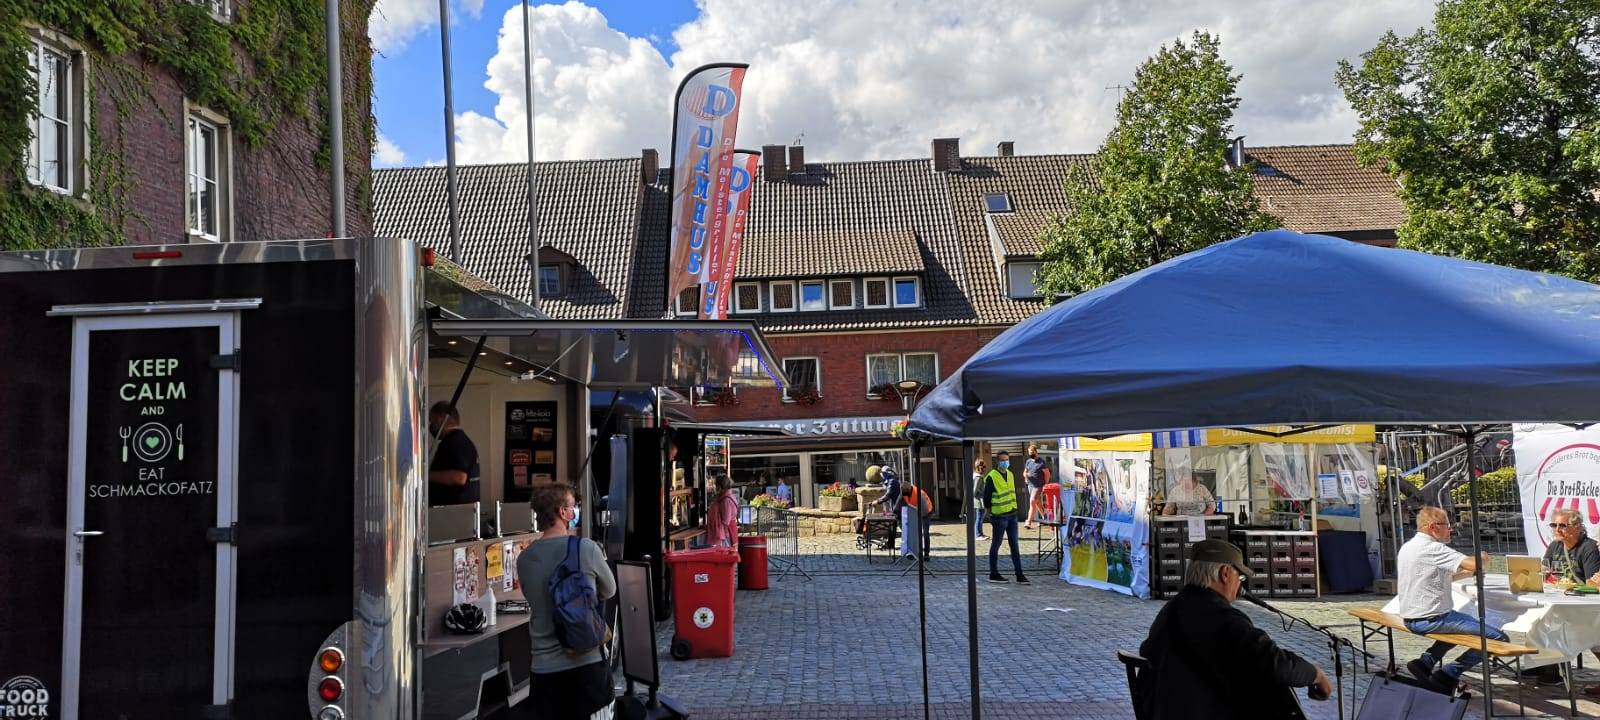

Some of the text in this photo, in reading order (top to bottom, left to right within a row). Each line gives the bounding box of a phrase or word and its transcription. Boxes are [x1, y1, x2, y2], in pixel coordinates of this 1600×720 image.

[687, 125, 714, 275] DAMHUS
[128, 358, 179, 378] KEEP
[119, 381, 186, 402] CALM
[140, 406, 165, 416] AND
[139, 467, 165, 481] EAT
[89, 481, 213, 498] SCHMACKOFATZ
[1547, 480, 1558, 496] Die
